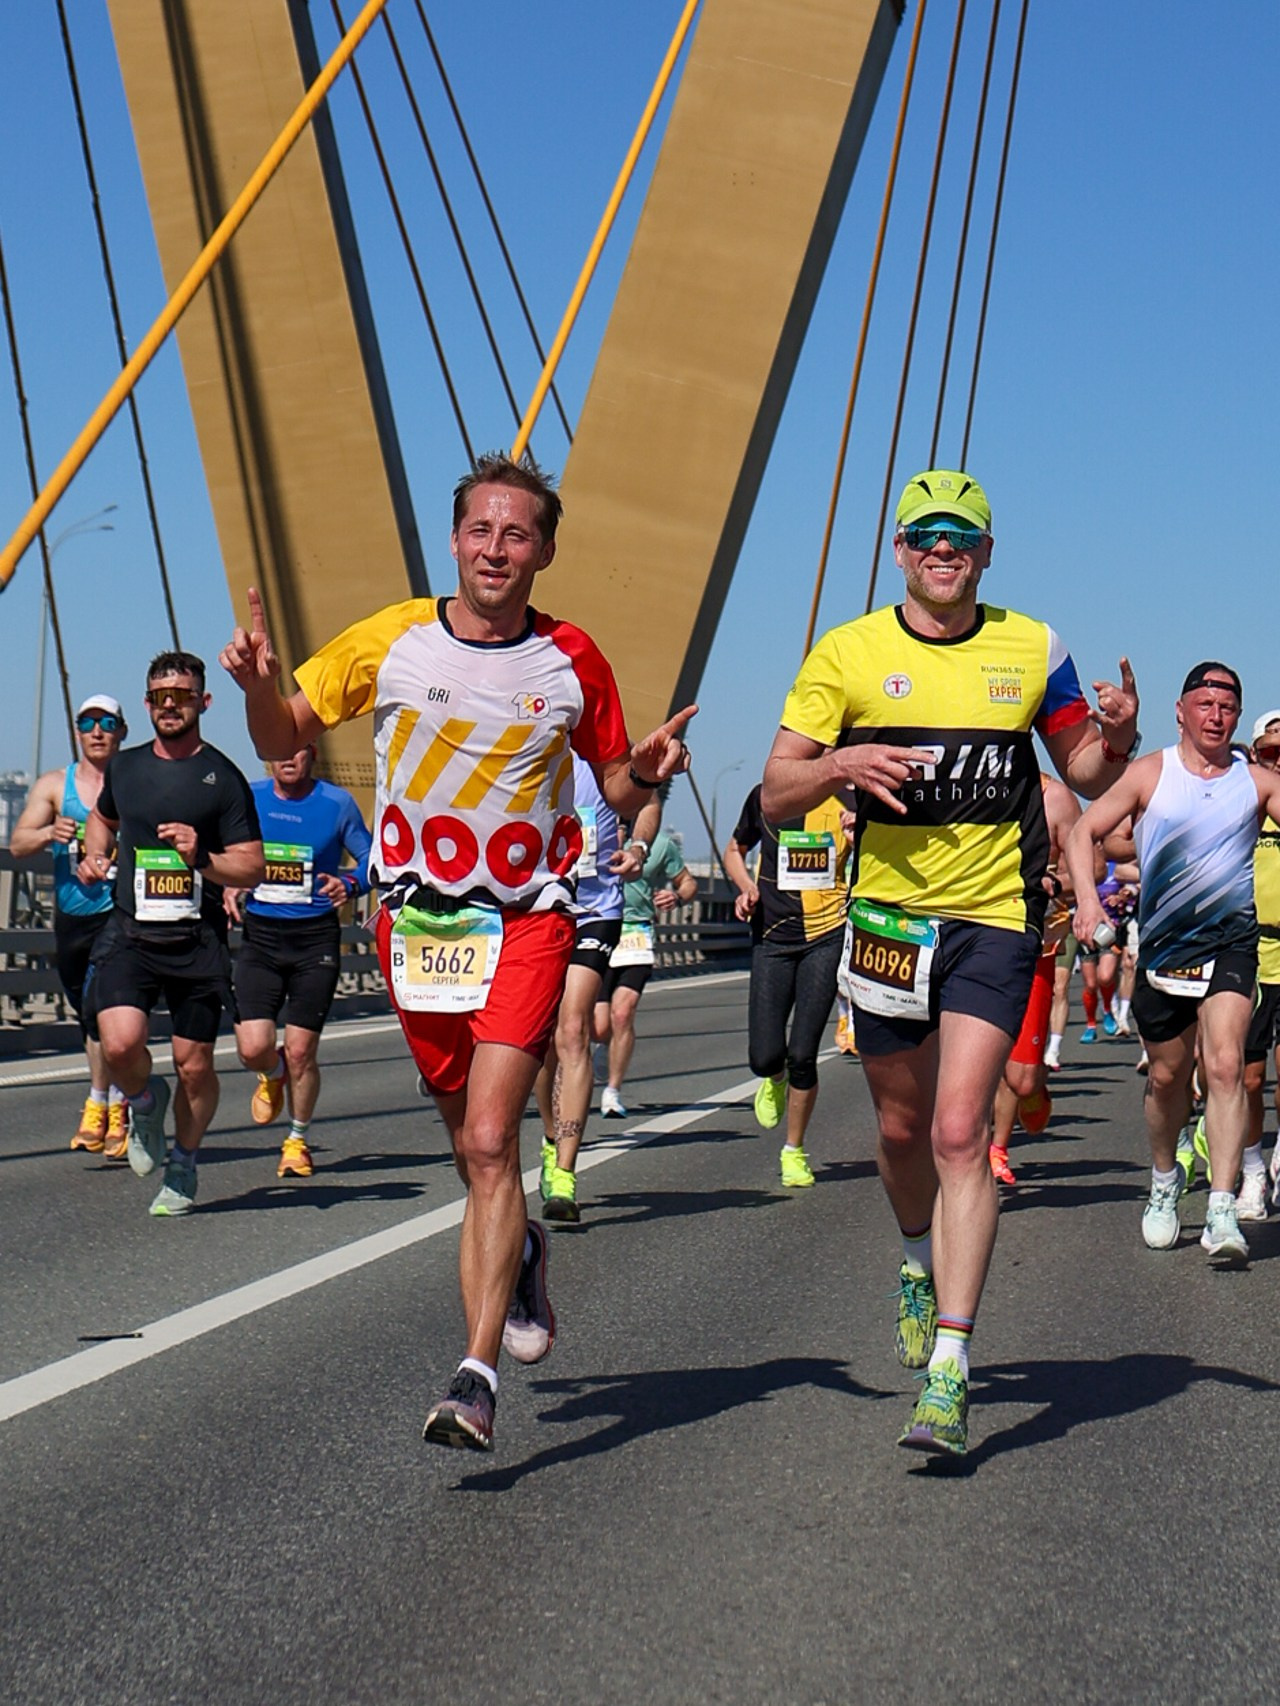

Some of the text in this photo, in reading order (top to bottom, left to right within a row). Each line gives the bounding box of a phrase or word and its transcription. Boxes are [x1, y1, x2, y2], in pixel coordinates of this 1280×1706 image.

[989, 686, 1022, 698] EXPERT
[791, 853, 827, 868] 17718
[265, 865, 302, 882] 17533
[148, 876, 192, 894] 16003
[393, 952, 404, 966] B
[421, 946, 475, 975] 5662
[855, 938, 912, 981] 16096
[432, 974, 460, 985] СЕРГЕЙ
